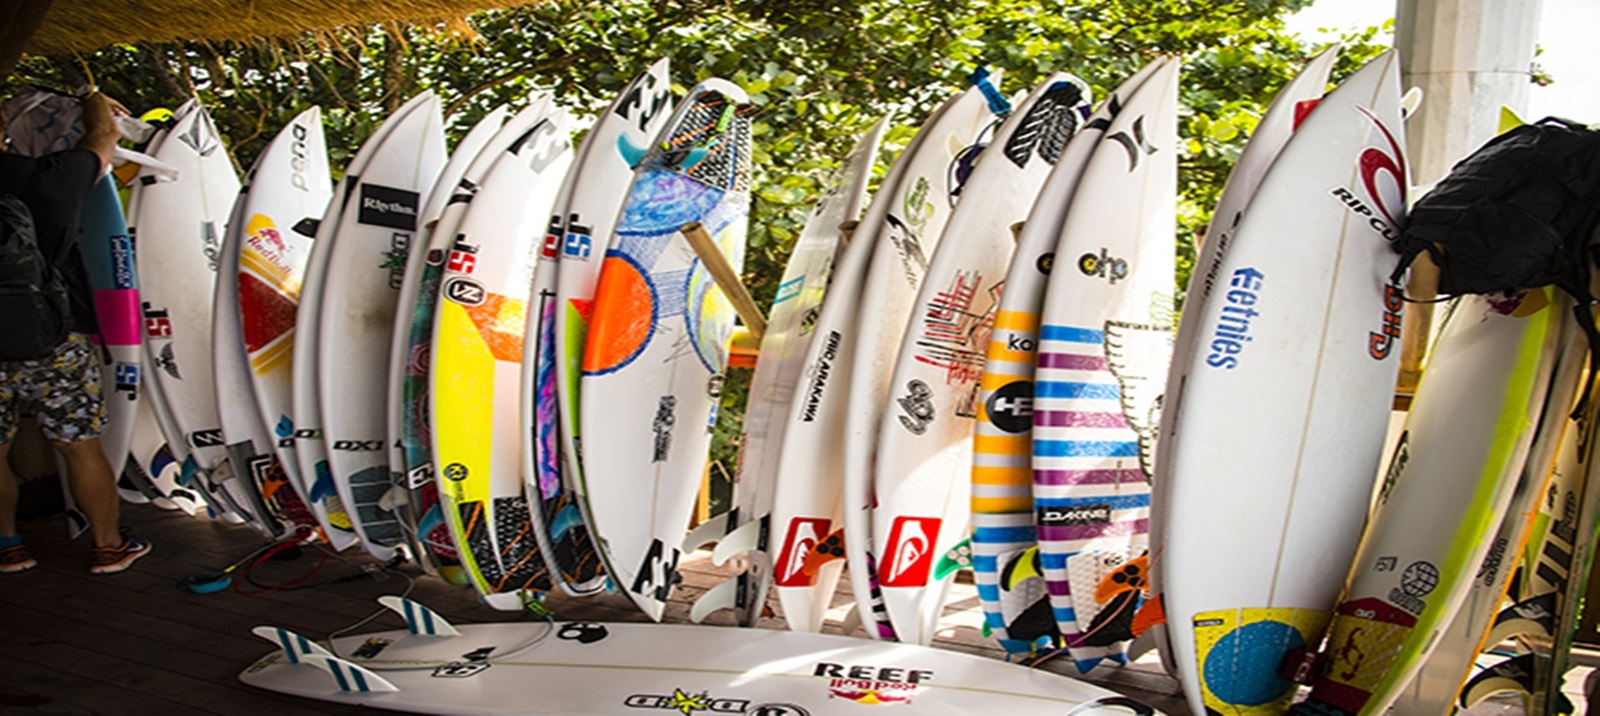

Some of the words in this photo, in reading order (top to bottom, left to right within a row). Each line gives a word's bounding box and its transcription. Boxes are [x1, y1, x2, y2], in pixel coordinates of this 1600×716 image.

[1332, 186, 1372, 217] RIP
[447, 233, 479, 274] JS
[565, 213, 592, 257] JS
[142, 301, 173, 337] JS
[1206, 284, 1259, 370] etnies
[824, 330, 842, 361] ERIC
[114, 362, 139, 401] JS
[803, 360, 831, 422] ARAKAWA
[333, 440, 384, 451] DX1
[813, 662, 934, 684] REEF
